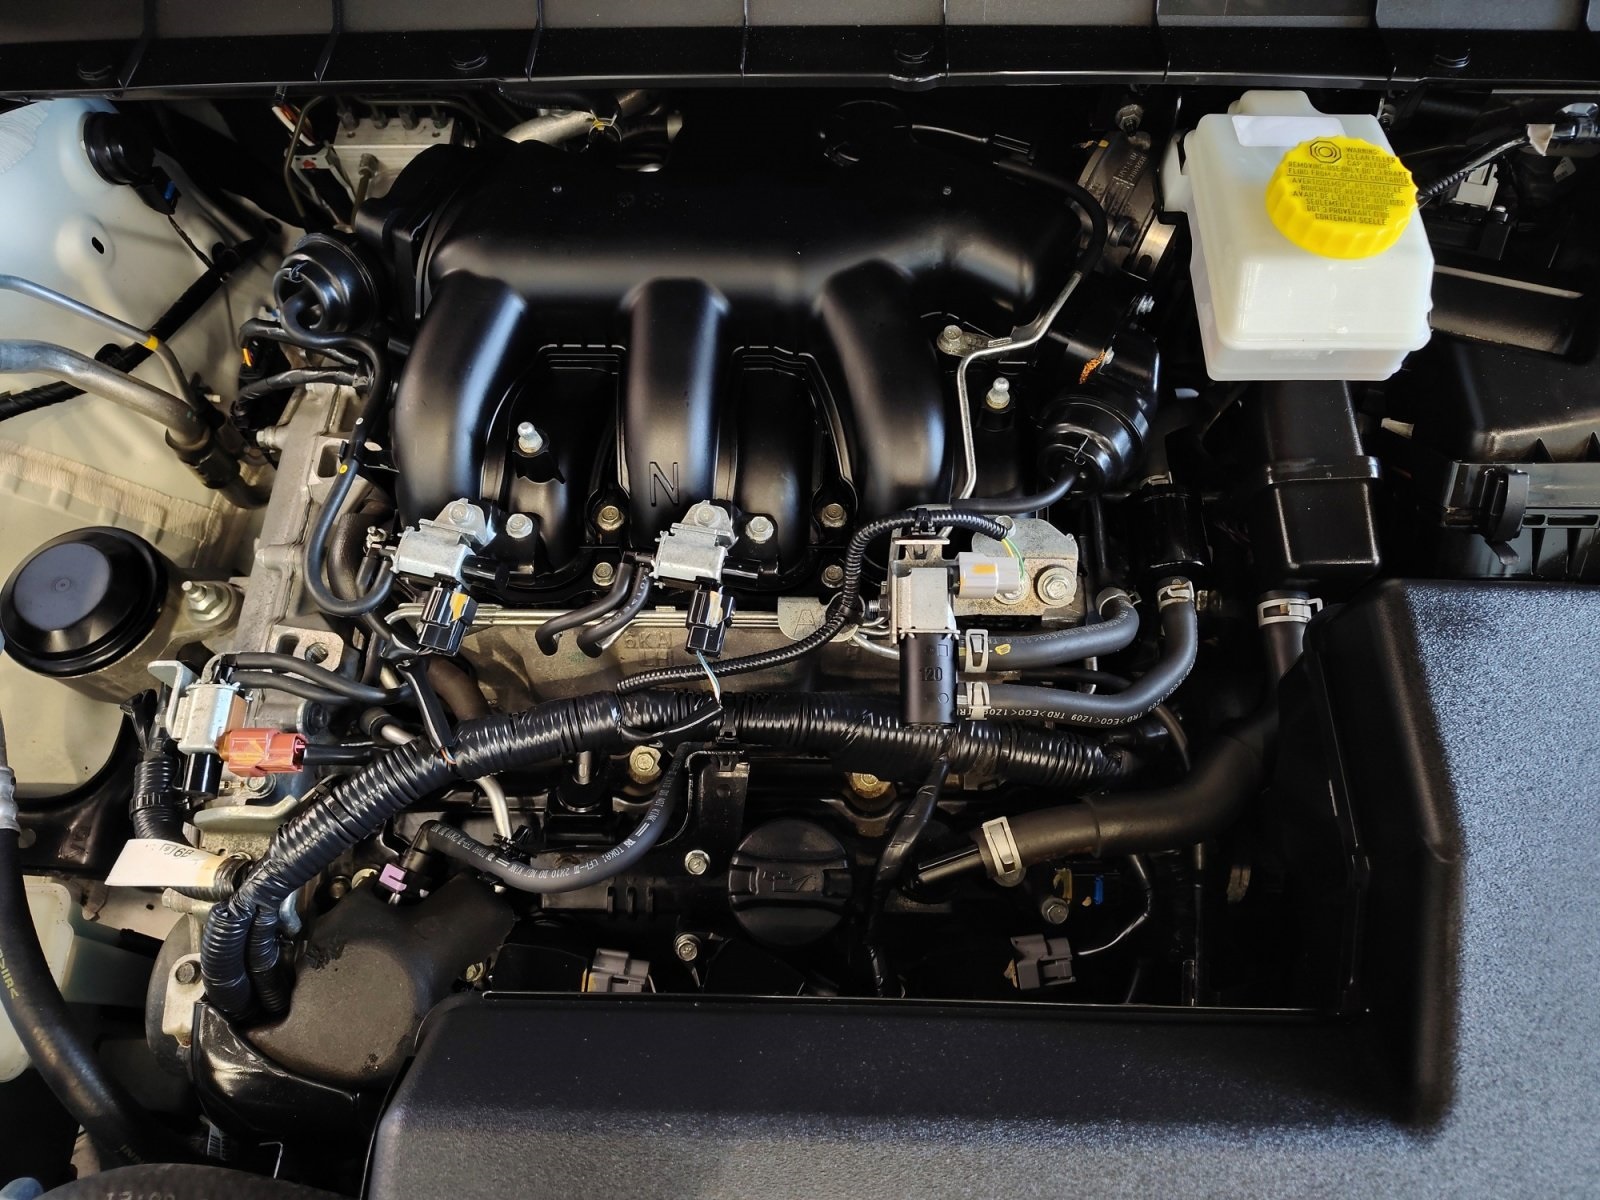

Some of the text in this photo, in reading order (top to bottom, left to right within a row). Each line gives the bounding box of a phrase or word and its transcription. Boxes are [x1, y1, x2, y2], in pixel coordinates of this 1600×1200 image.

[1347, 153, 1371, 161] CLEAN
[1341, 172, 1368, 180] SEALED
[1301, 185, 1334, 193] BOUCHON
[1306, 199, 1348, 208] SEULEMENT
[1329, 207, 1372, 217] PROVENANT
[1315, 213, 1357, 223] CONTENANT
[649, 461, 680, 507] N
[603, 847, 625, 863] TOKAI
